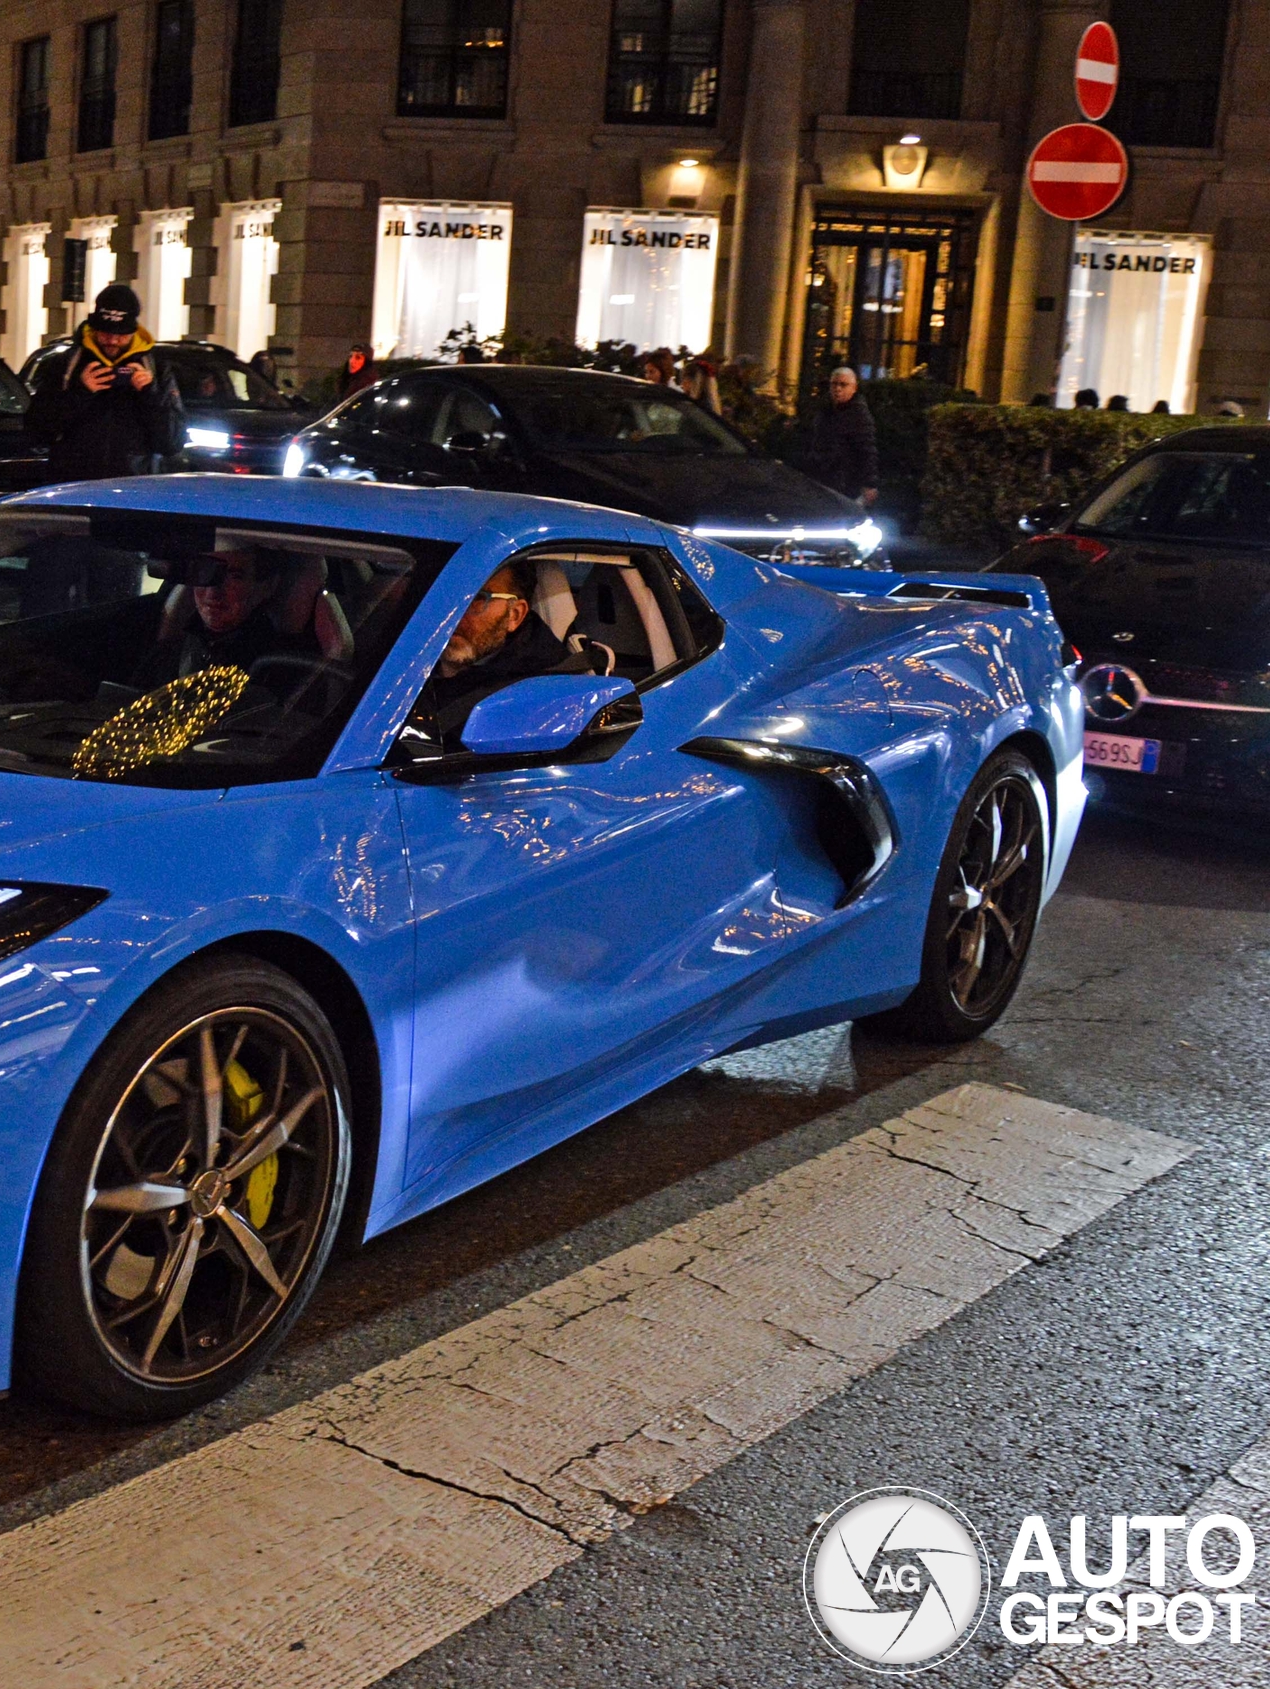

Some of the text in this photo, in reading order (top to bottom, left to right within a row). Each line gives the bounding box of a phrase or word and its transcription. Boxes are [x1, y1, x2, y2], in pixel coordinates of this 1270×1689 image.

[385, 221, 504, 240] JIL SANDER
[590, 229, 711, 249] JIL SANDER
[1104, 253, 1196, 274] SANDER
